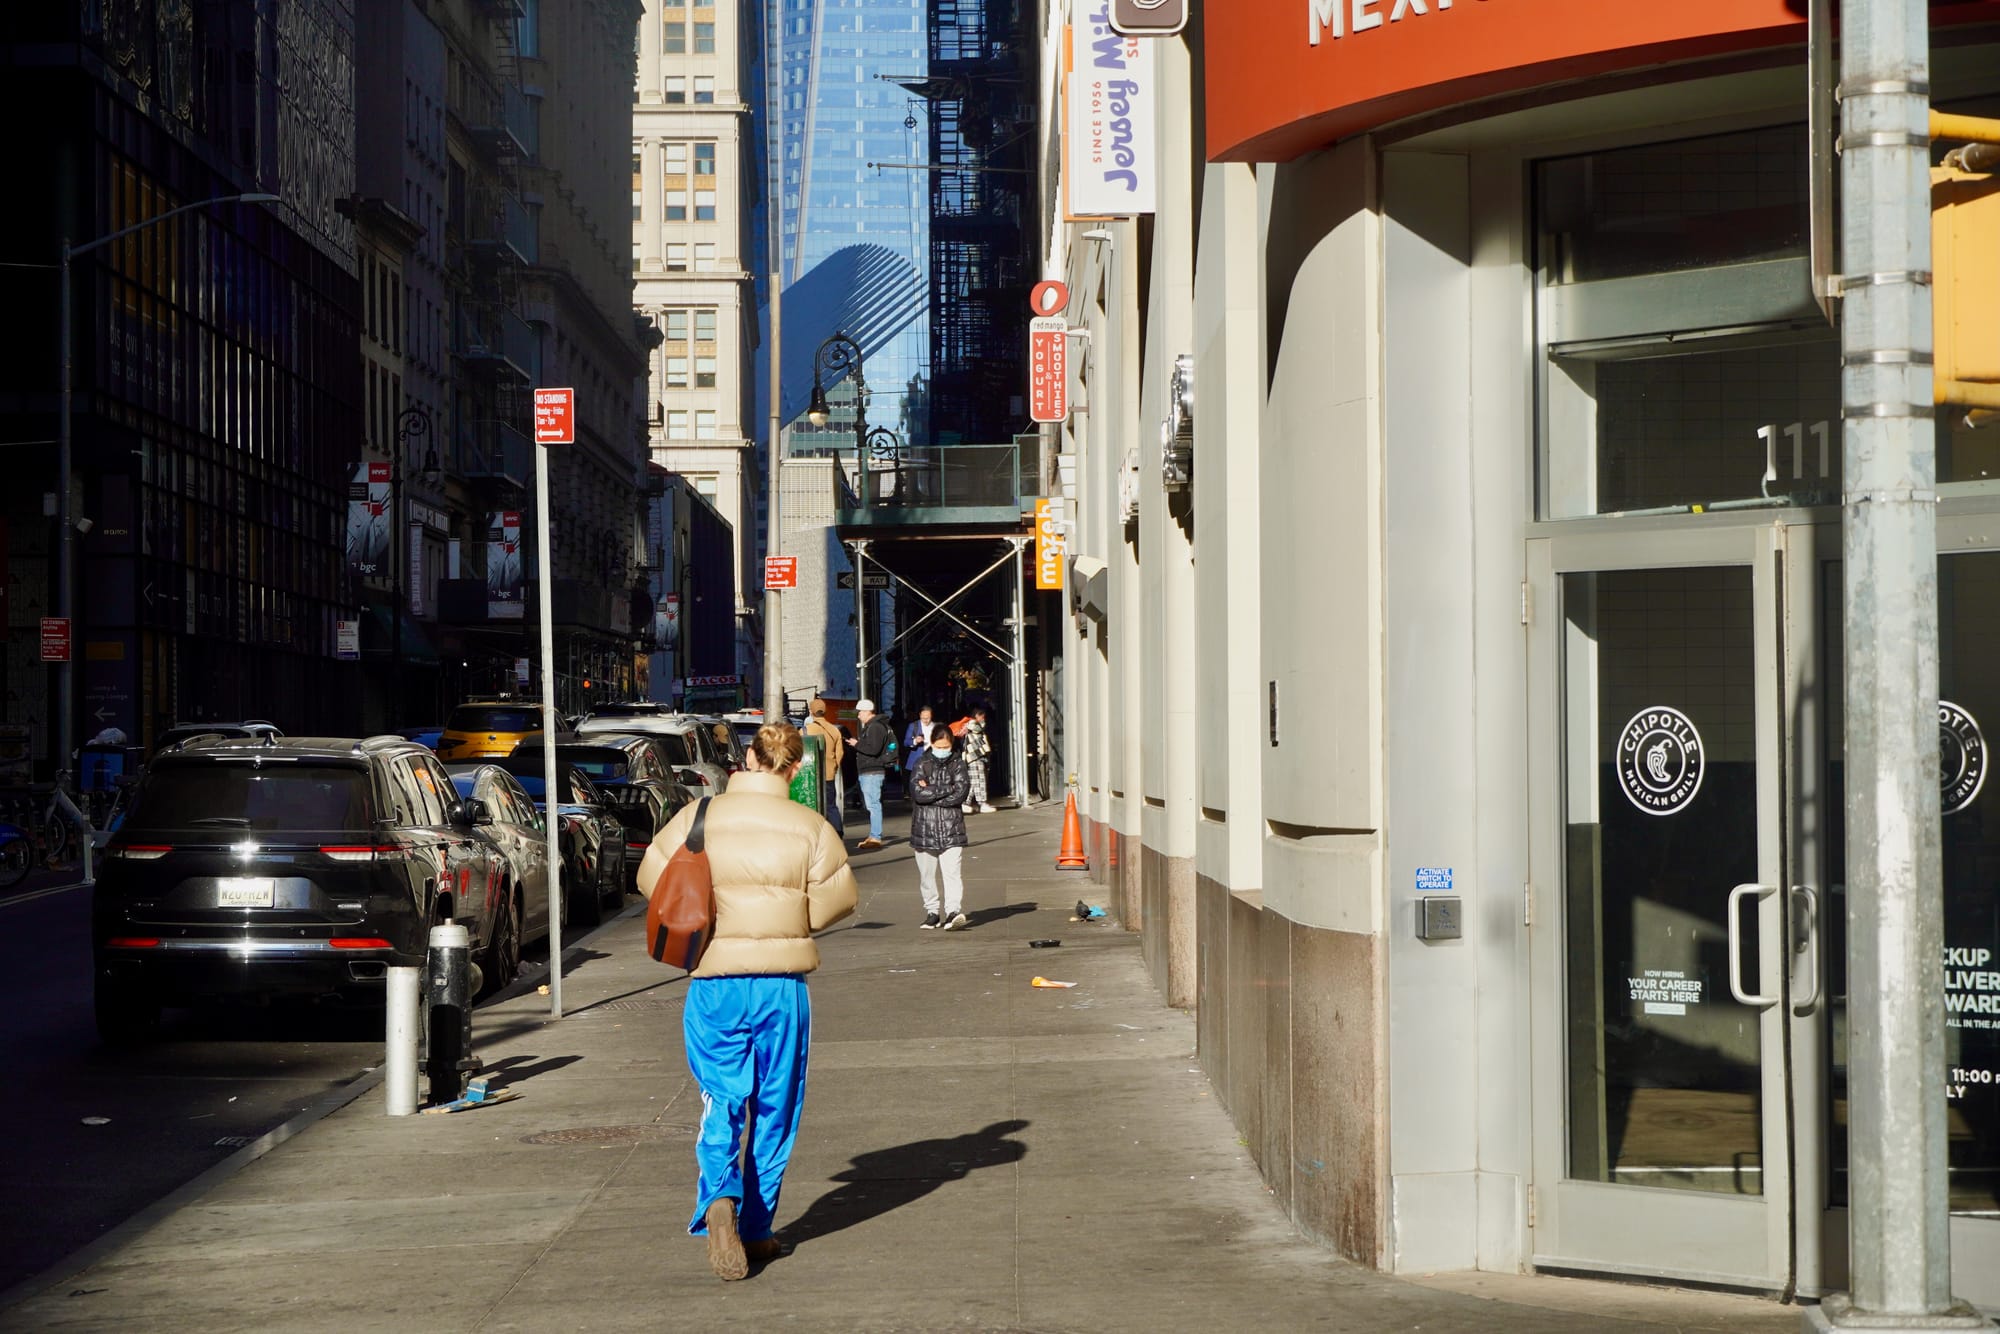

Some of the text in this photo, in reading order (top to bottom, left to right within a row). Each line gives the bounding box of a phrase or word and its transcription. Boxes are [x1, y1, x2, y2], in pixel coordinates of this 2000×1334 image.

[1127, 36, 1139, 58] Su
[1092, 81, 1102, 163] SINCE 1956
[1104, 79, 1139, 192] Jersey
[1035, 338, 1044, 411] YOGURT
[1045, 371, 1052, 380] &
[1052, 334, 1062, 418] SMOOTHIES
[536, 394, 566, 404] NO STANDING
[360, 561, 377, 574] bgc
[690, 675, 738, 685] TACOS
[1624, 713, 1698, 754] CHIPOTLE
[1939, 708, 1979, 751] OTLE
[1625, 769, 1696, 806] MEXICAN GRILL
[1949, 770, 1977, 803] GRILL
[1644, 969, 1661, 977] NOW
[1945, 970, 2000, 990] LIVER
[1627, 977, 1702, 992] YOUR CAREER
[1630, 989, 1700, 1003] STARTS HERE
[1944, 993, 2000, 1013] WARD
[1946, 1018, 1961, 1027] ALL
[1963, 1019, 1972, 1028] IN
[1973, 1019, 1990, 1029] THE
[1952, 1068, 1992, 1084] 11:00
[1945, 1085, 1967, 1098] LY
